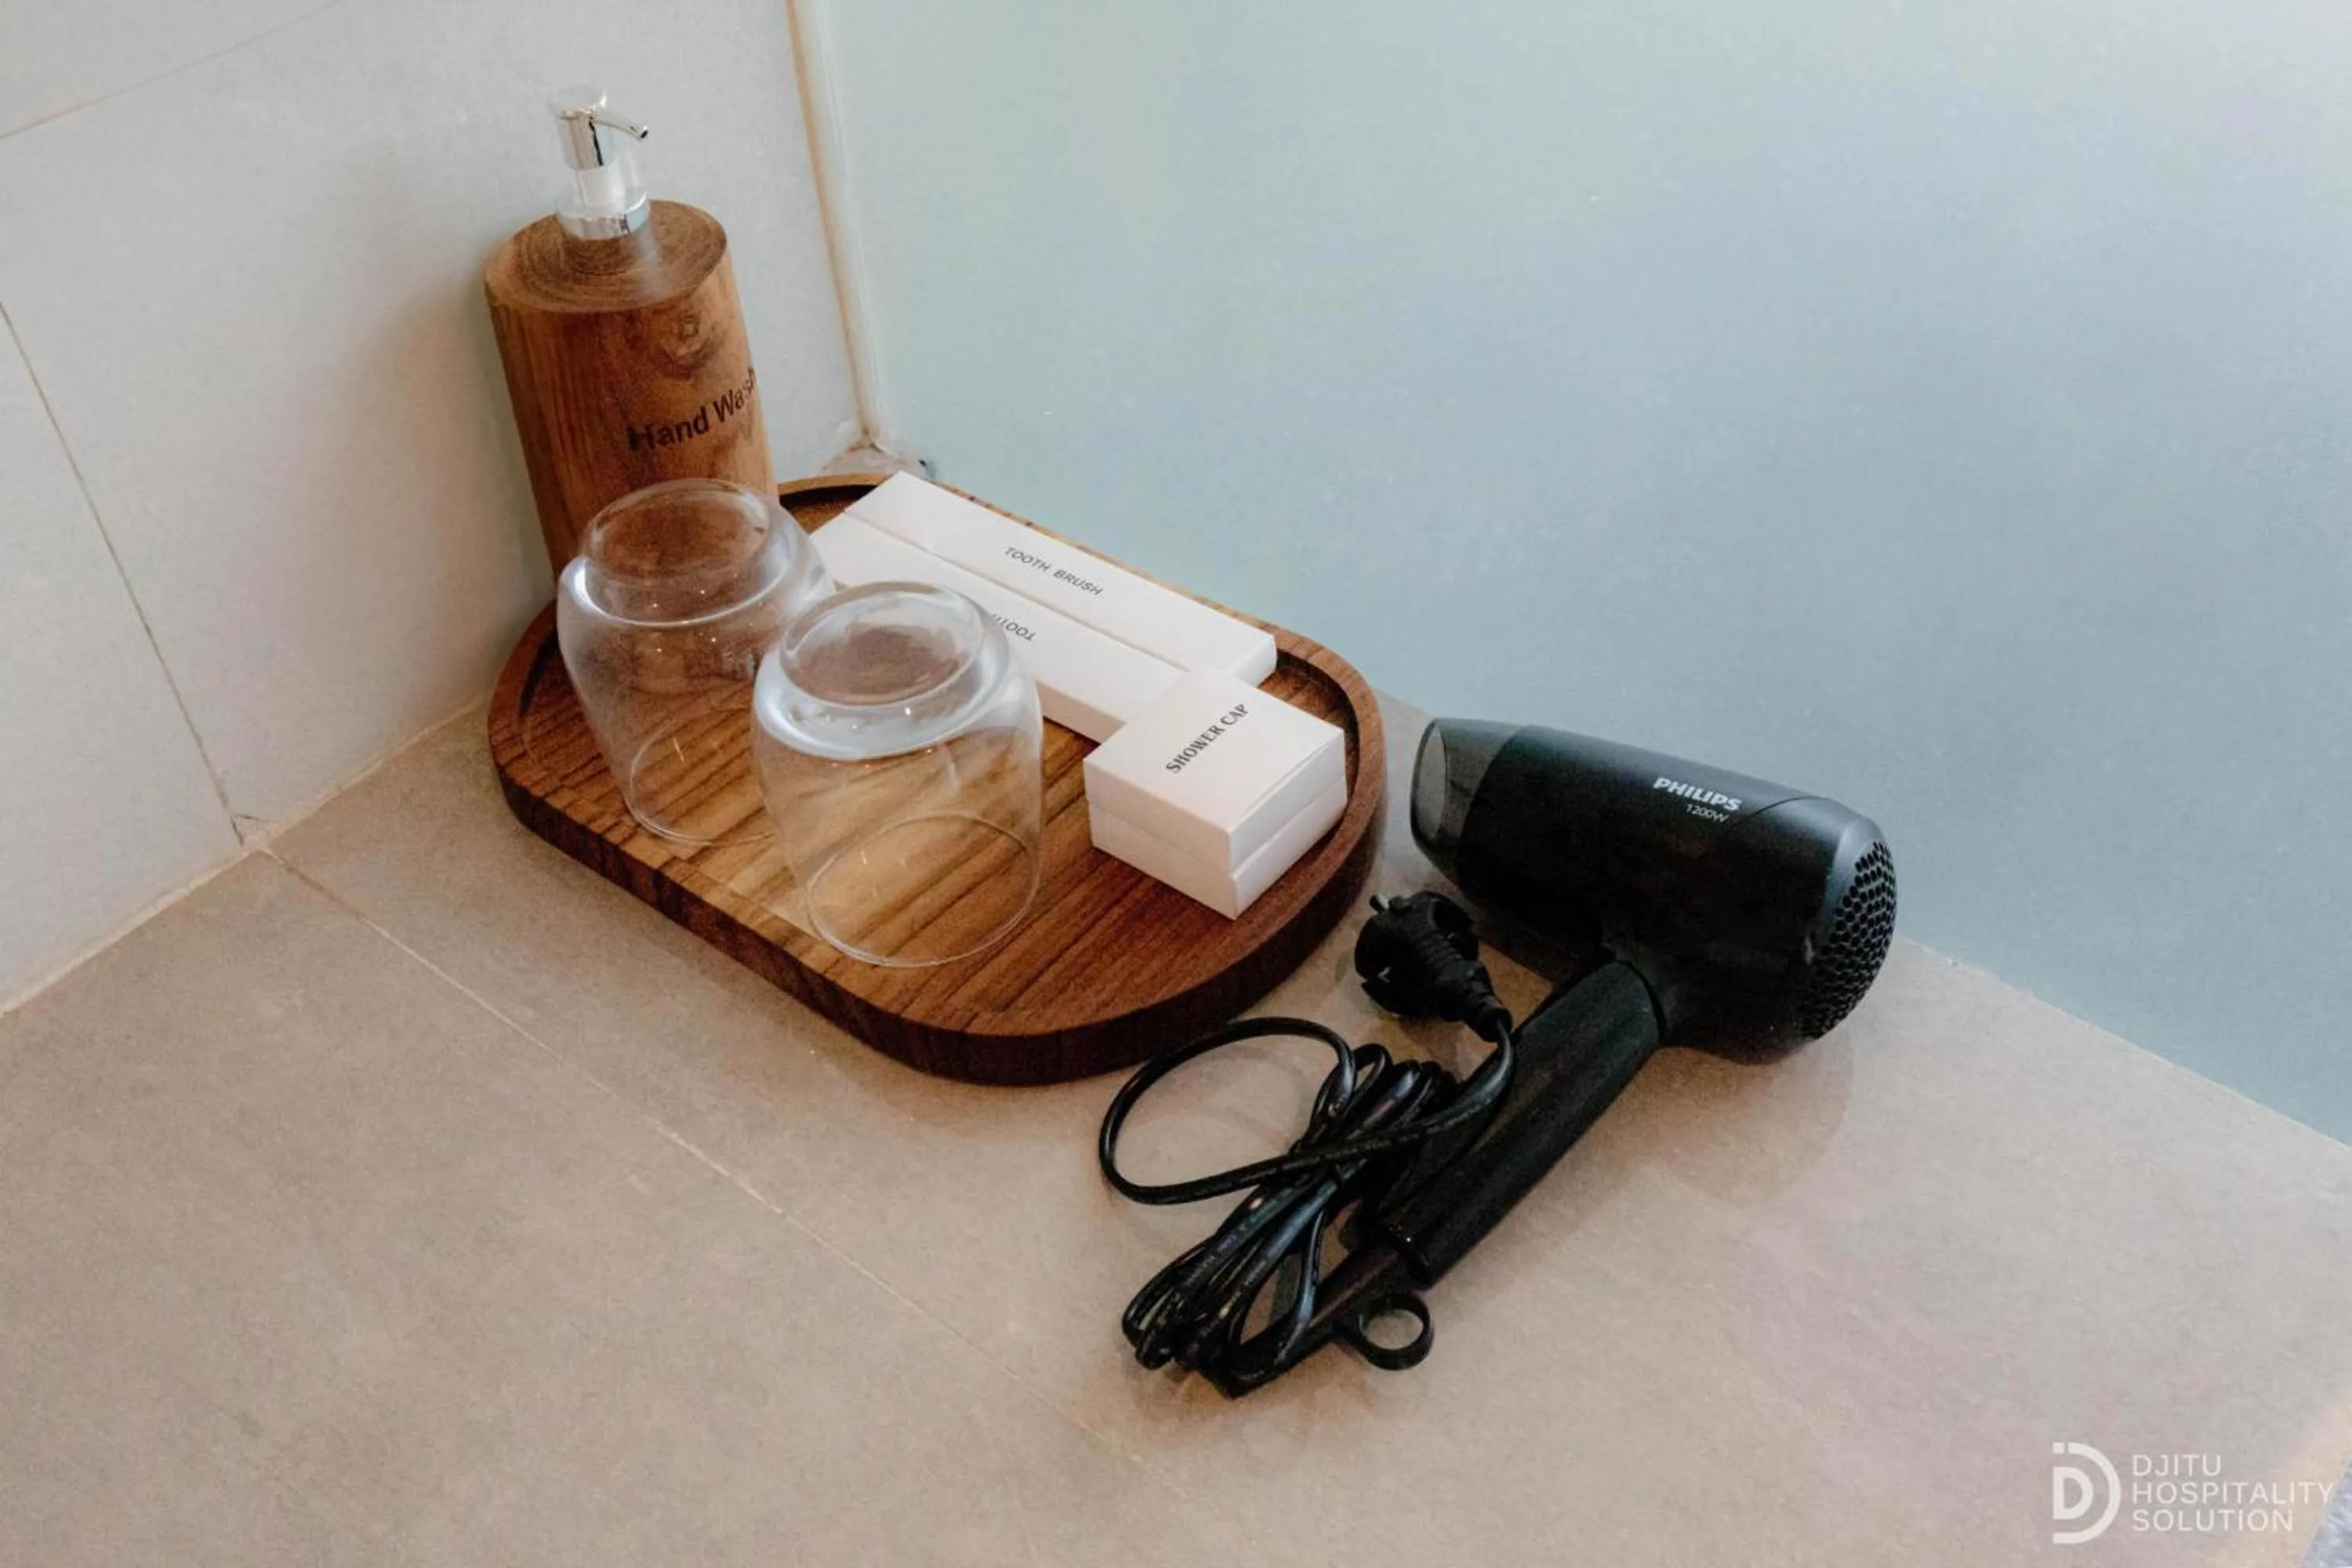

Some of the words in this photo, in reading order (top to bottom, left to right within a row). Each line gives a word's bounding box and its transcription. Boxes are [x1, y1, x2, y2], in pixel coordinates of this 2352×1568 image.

[627, 405, 710, 451] Hand
[1004, 546, 1052, 572] TOOTH
[1053, 569, 1104, 596] BRUSH
[1166, 724, 1226, 775] SHOWER
[1220, 703, 1249, 726] CAP
[1653, 777, 1743, 811] PHILIPS
[1686, 804, 1730, 822] 1200W
